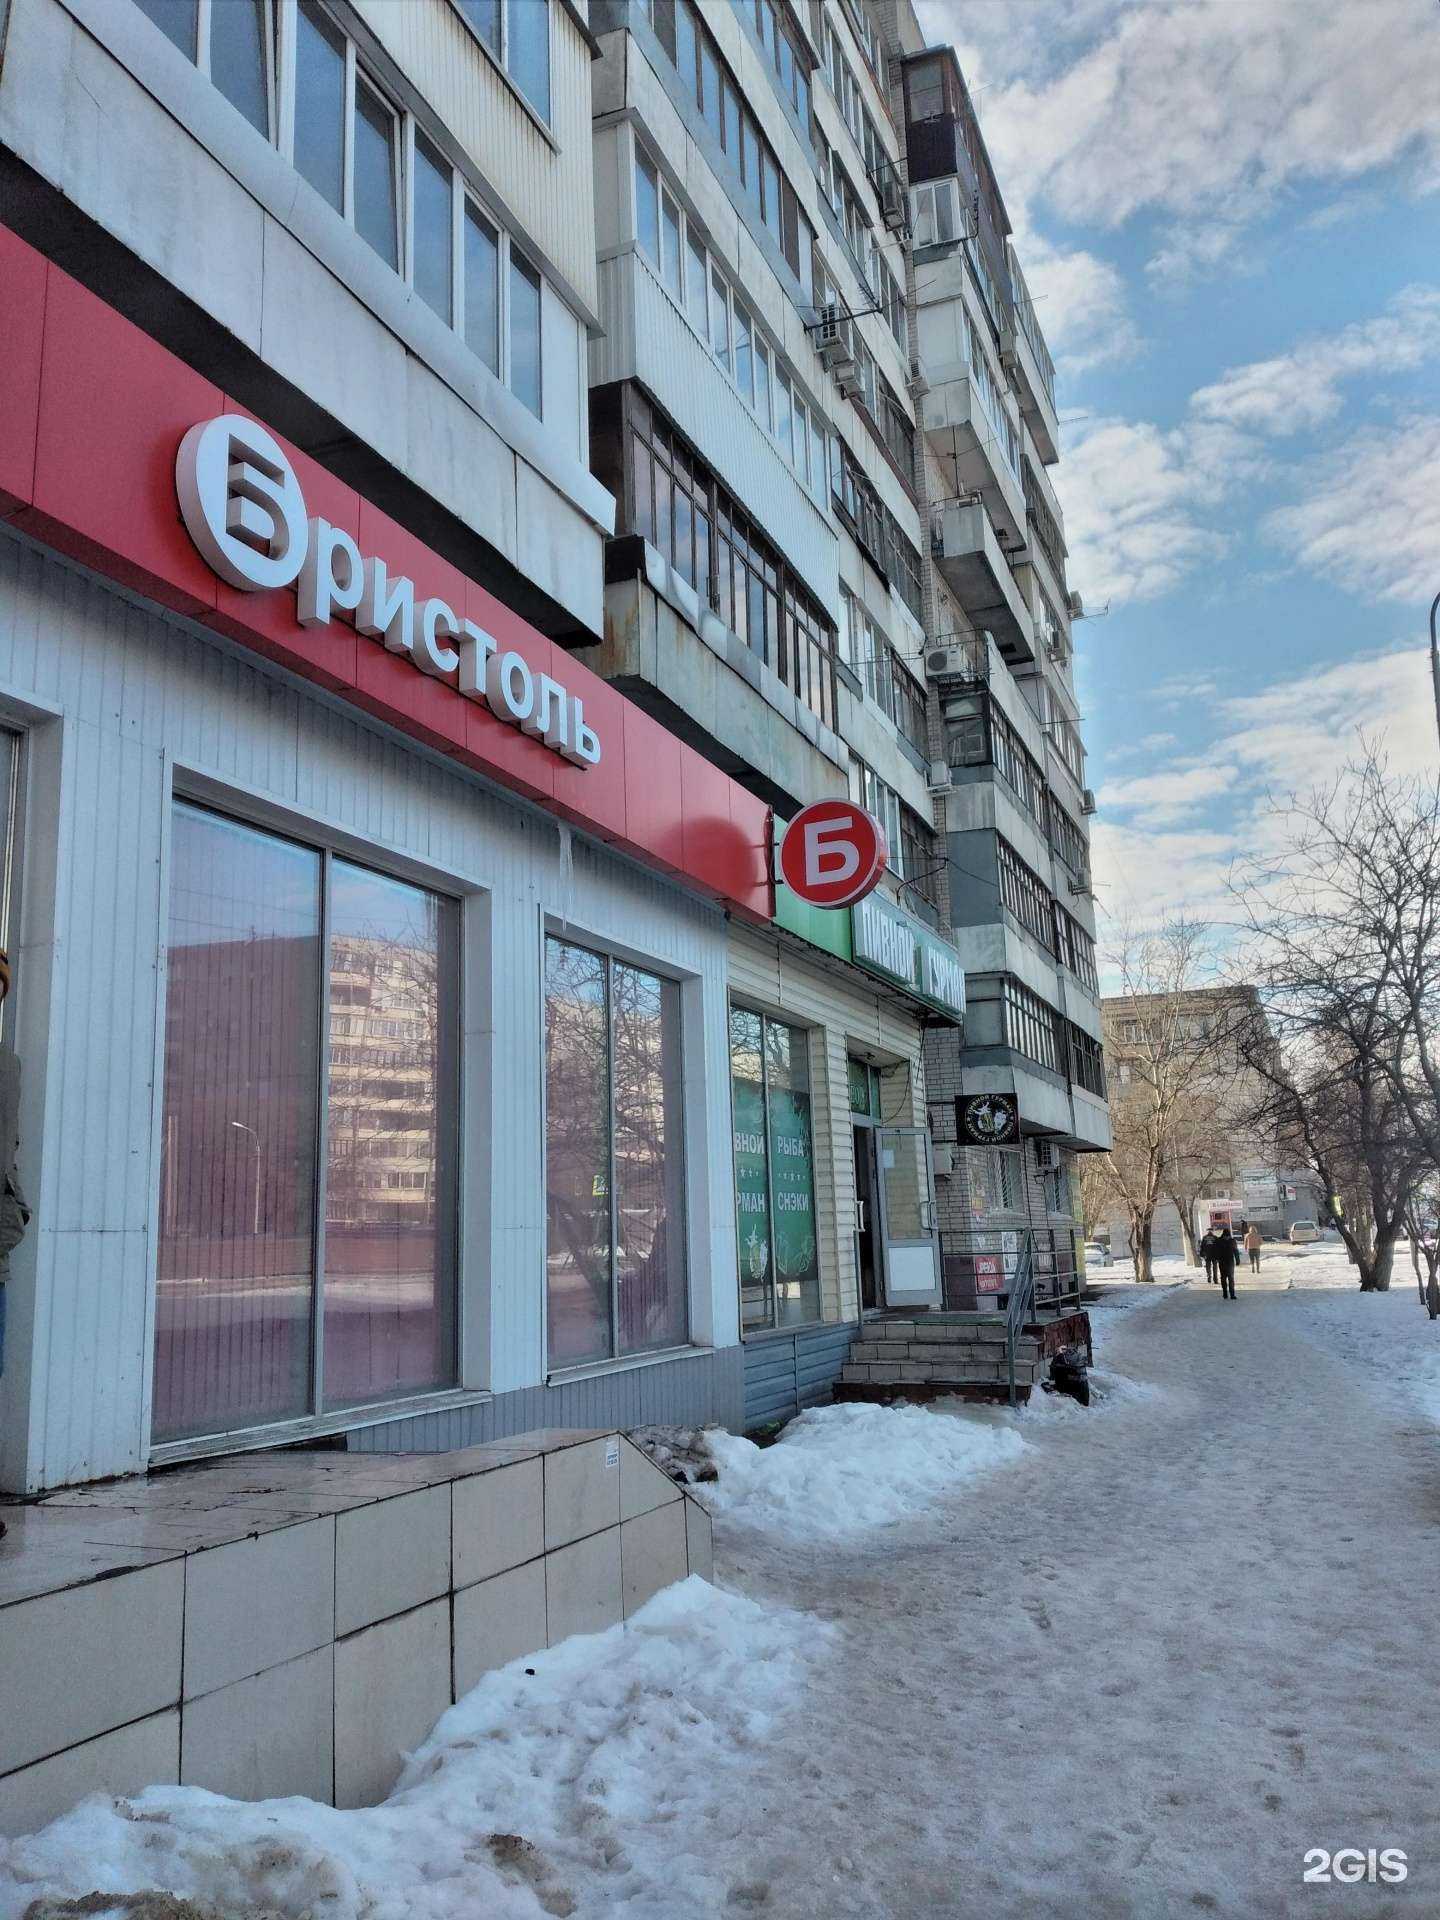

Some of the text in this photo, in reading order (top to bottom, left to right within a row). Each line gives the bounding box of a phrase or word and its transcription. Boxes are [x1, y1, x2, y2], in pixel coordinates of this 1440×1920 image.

[176, 413, 601, 766] Бристоль
[804, 816, 860, 887] Б
[777, 1135, 804, 1157] РЫБА
[777, 1191, 809, 1212] СНЭКИ
